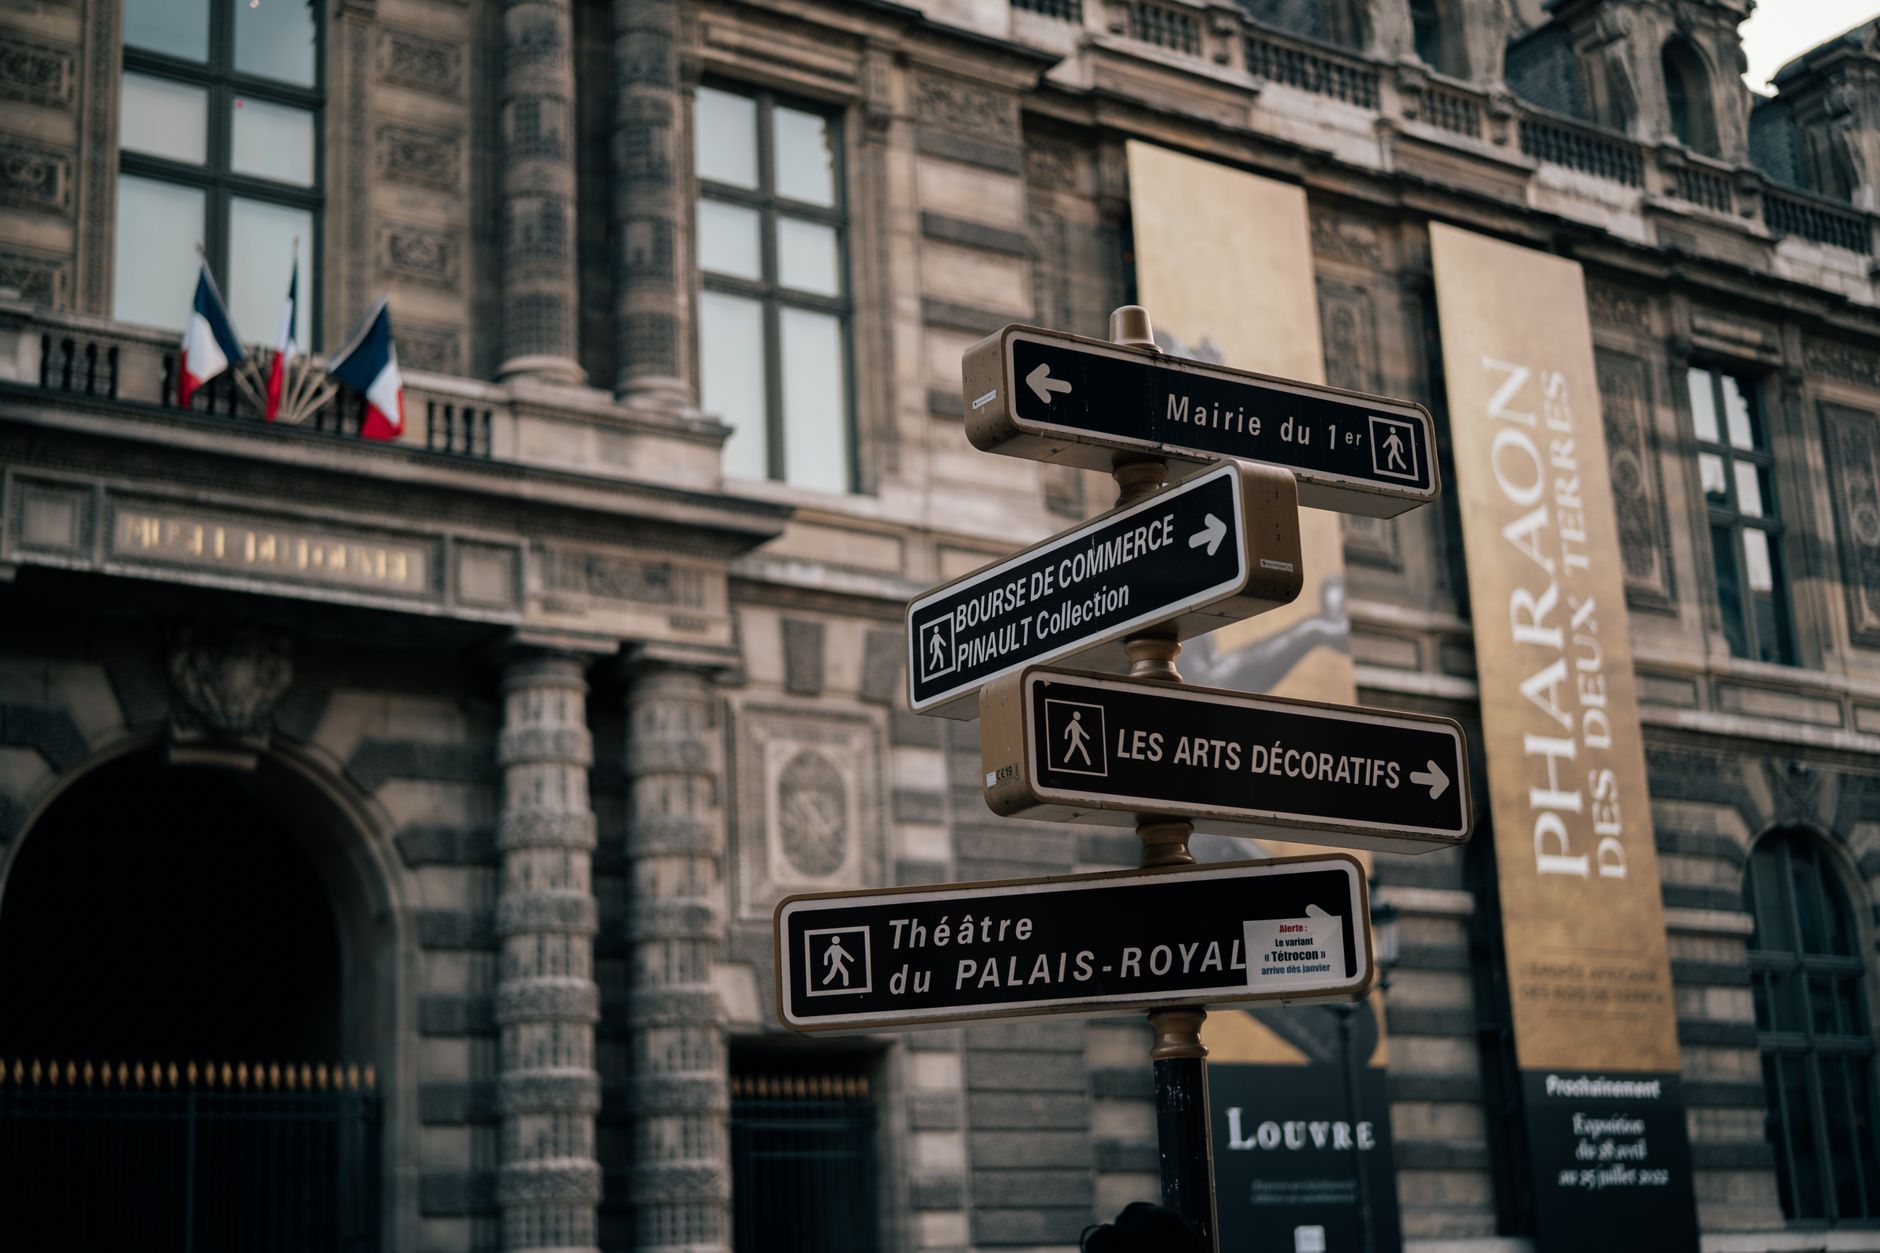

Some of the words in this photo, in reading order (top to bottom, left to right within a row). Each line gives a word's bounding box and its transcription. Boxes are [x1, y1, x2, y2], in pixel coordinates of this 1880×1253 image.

[1166, 393, 1261, 436] Mairie
[1280, 416, 1310, 446] du
[1328, 424, 1362, 450] 1er
[1540, 369, 1589, 577] TERRES
[955, 577, 1026, 633] BOURSE
[1030, 565, 1054, 602] DE
[1058, 513, 1174, 589] COMMERCE
[957, 616, 1033, 673] PINAULT
[1036, 584, 1129, 640] Collection
[1481, 355, 1590, 879] PHARAON
[1567, 596, 1612, 750] DEUX
[1117, 728, 1163, 762] LES
[1173, 736, 1241, 771] ARTS
[1251, 741, 1400, 789] DÉCORATIFS
[1588, 768, 1627, 880] DES
[889, 914, 1033, 950] Théâtre
[1271, 950, 1318, 962] Tétrocon
[1275, 938, 1284, 947] Le
[1285, 937, 1313, 947] variant
[1279, 924, 1303, 933] Alerte
[889, 964, 931, 995] du
[955, 939, 1246, 990] PALAIS-ROYAL
[1261, 966, 1285, 975] arrive
[1286, 965, 1301, 974] dès
[1302, 964, 1330, 974] janvier
[1546, 1074, 1660, 1098] Prochainement
